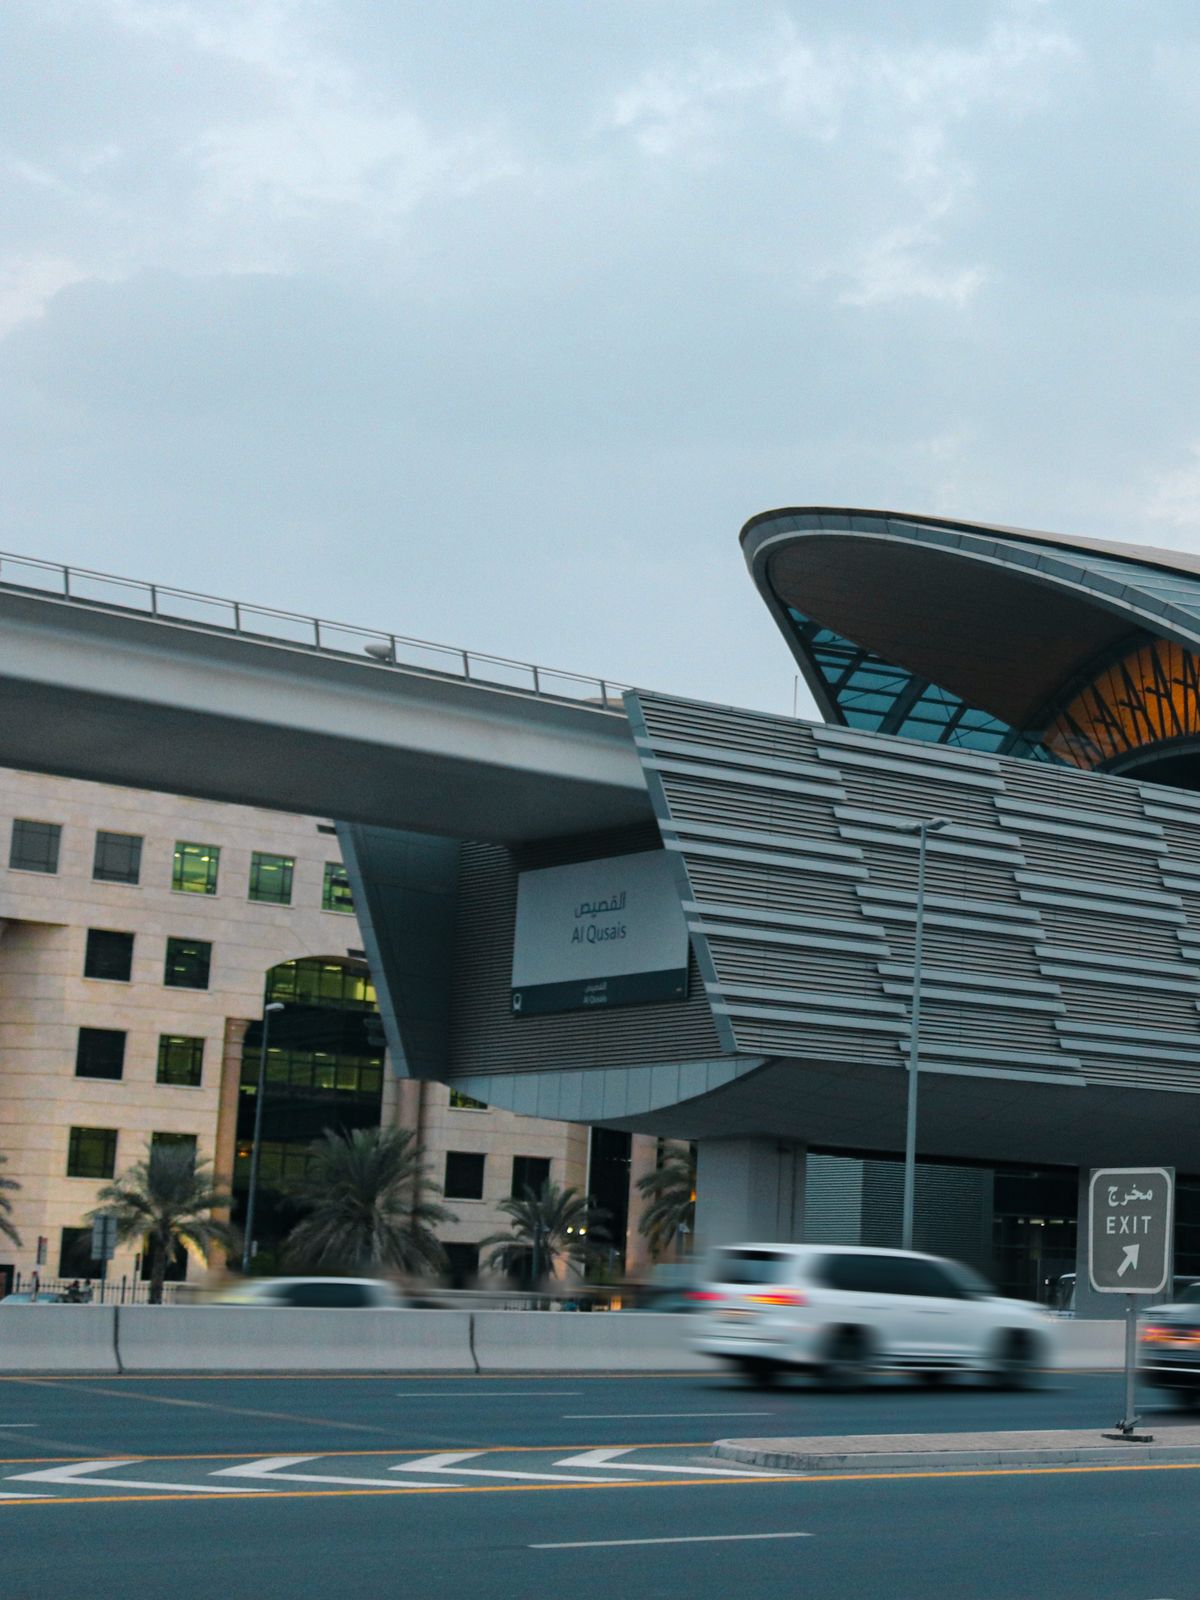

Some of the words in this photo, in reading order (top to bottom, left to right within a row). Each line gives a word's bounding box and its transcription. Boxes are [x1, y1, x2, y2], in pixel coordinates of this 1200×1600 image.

[574, 891, 626, 919] القصيص
[570, 926, 584, 944] Al
[586, 921, 626, 944] Qusais
[1107, 1183, 1153, 1207] مخرج
[1106, 1215, 1152, 1235] EXIT
